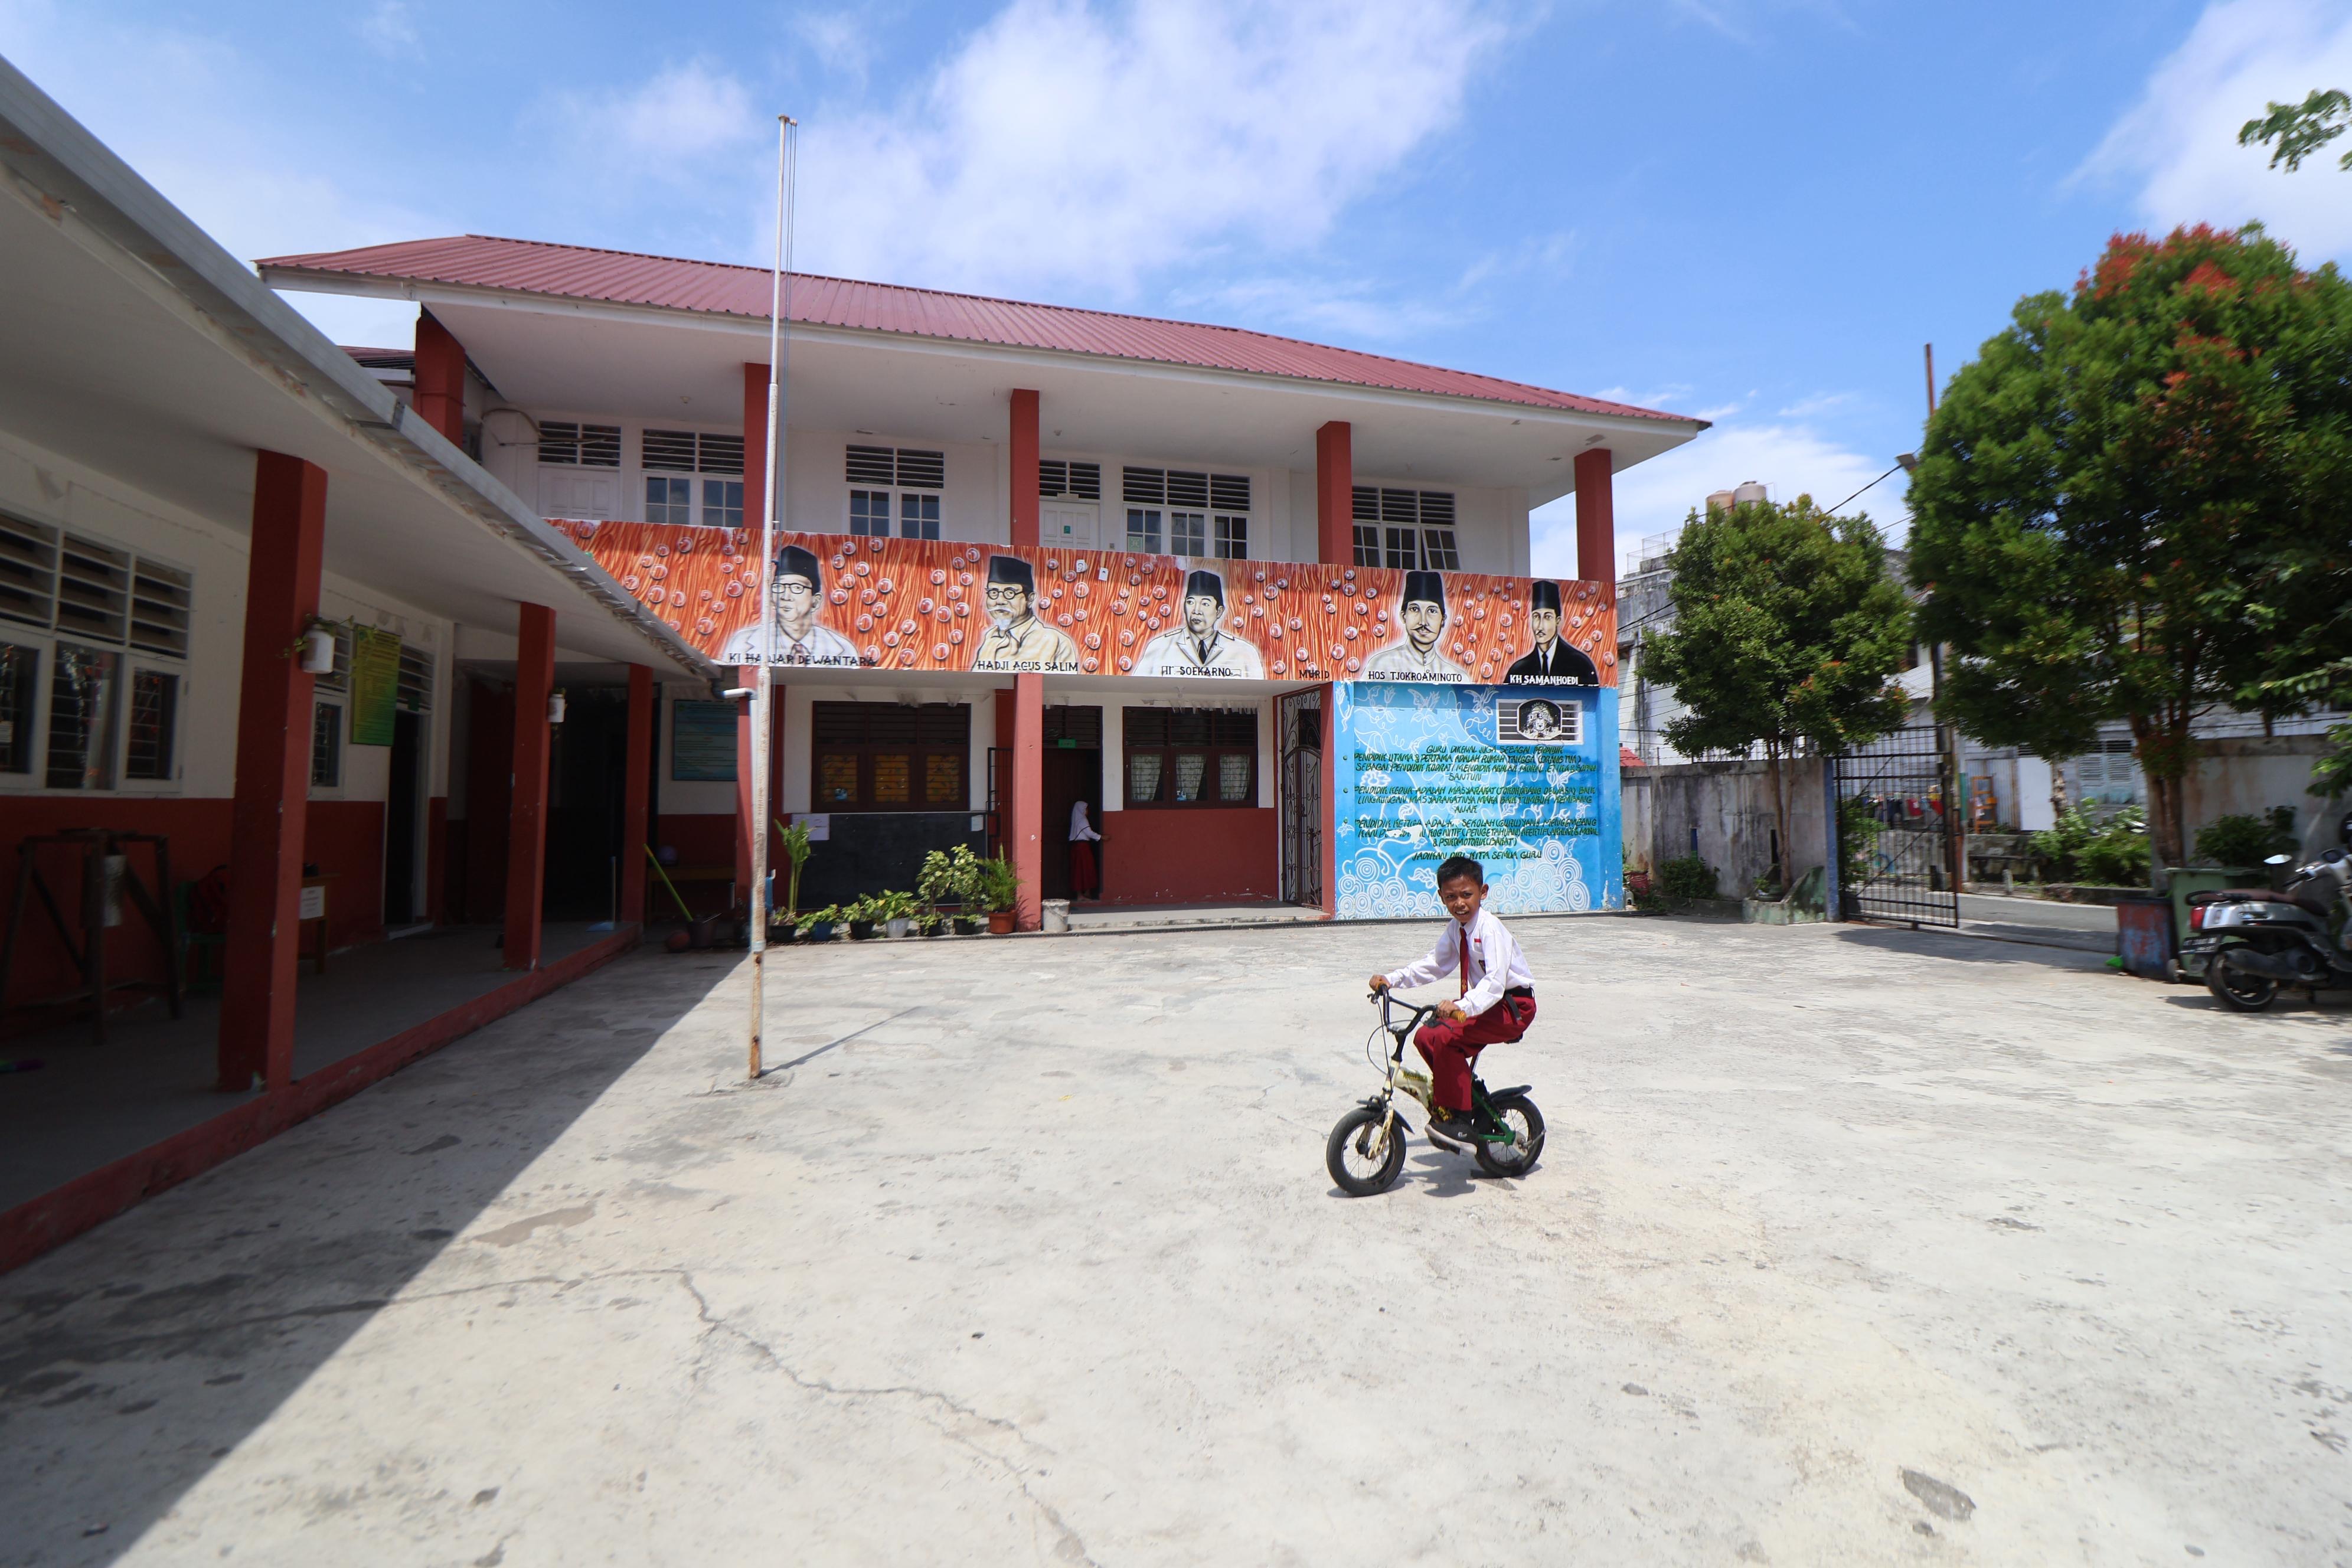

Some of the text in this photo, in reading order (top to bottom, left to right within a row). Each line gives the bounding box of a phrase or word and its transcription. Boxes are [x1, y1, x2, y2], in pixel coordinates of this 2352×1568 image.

[729, 653, 877, 667] KI HAJAR DEWANTARA
[977, 661, 1079, 671] HADJI AGUS SALIM
[1299, 670, 1329, 678] MURID
[1368, 671, 1462, 682] HOS TJOKROAMINOTO
[1510, 675, 1579, 685] KH SAMANHOEDI
[1426, 745, 1446, 753] GURU
[1451, 745, 1477, 753] DIKENAL
[1500, 746, 1530, 754] SEBAGAI
[1354, 753, 1387, 762] PENDIDIK
[1389, 753, 1413, 762] UTAMA
[1420, 754, 1452, 763] PERTAMA
[1455, 754, 1480, 763] ADALAH
[1482, 755, 1504, 763] RUMAH
[1508, 755, 1535, 763] TANGGA
[1355, 763, 1389, 771] SEBAGAI
[1390, 763, 1425, 772] PENDIDIK
[1456, 764, 1491, 772] MENDIDIK
[1448, 773, 1482, 781] SANTUN
[1354, 786, 1388, 794] PENDIDIK
[1389, 786, 1413, 795] KEDUA
[1415, 786, 1446, 795] ADALAH
[1448, 786, 1496, 795] MASYARAKAT
[1358, 796, 1407, 804] LINGKUNGAN
[1454, 805, 1478, 814] ANAK
[1354, 818, 1391, 828] PENDIDIK
[1462, 819, 1495, 828] SEKOLAH
[1412, 851, 1446, 861] JADIKAN
[1469, 851, 1489, 860] KITA
[1492, 851, 1518, 860] SEMUA
[1520, 851, 1541, 860] GURU
